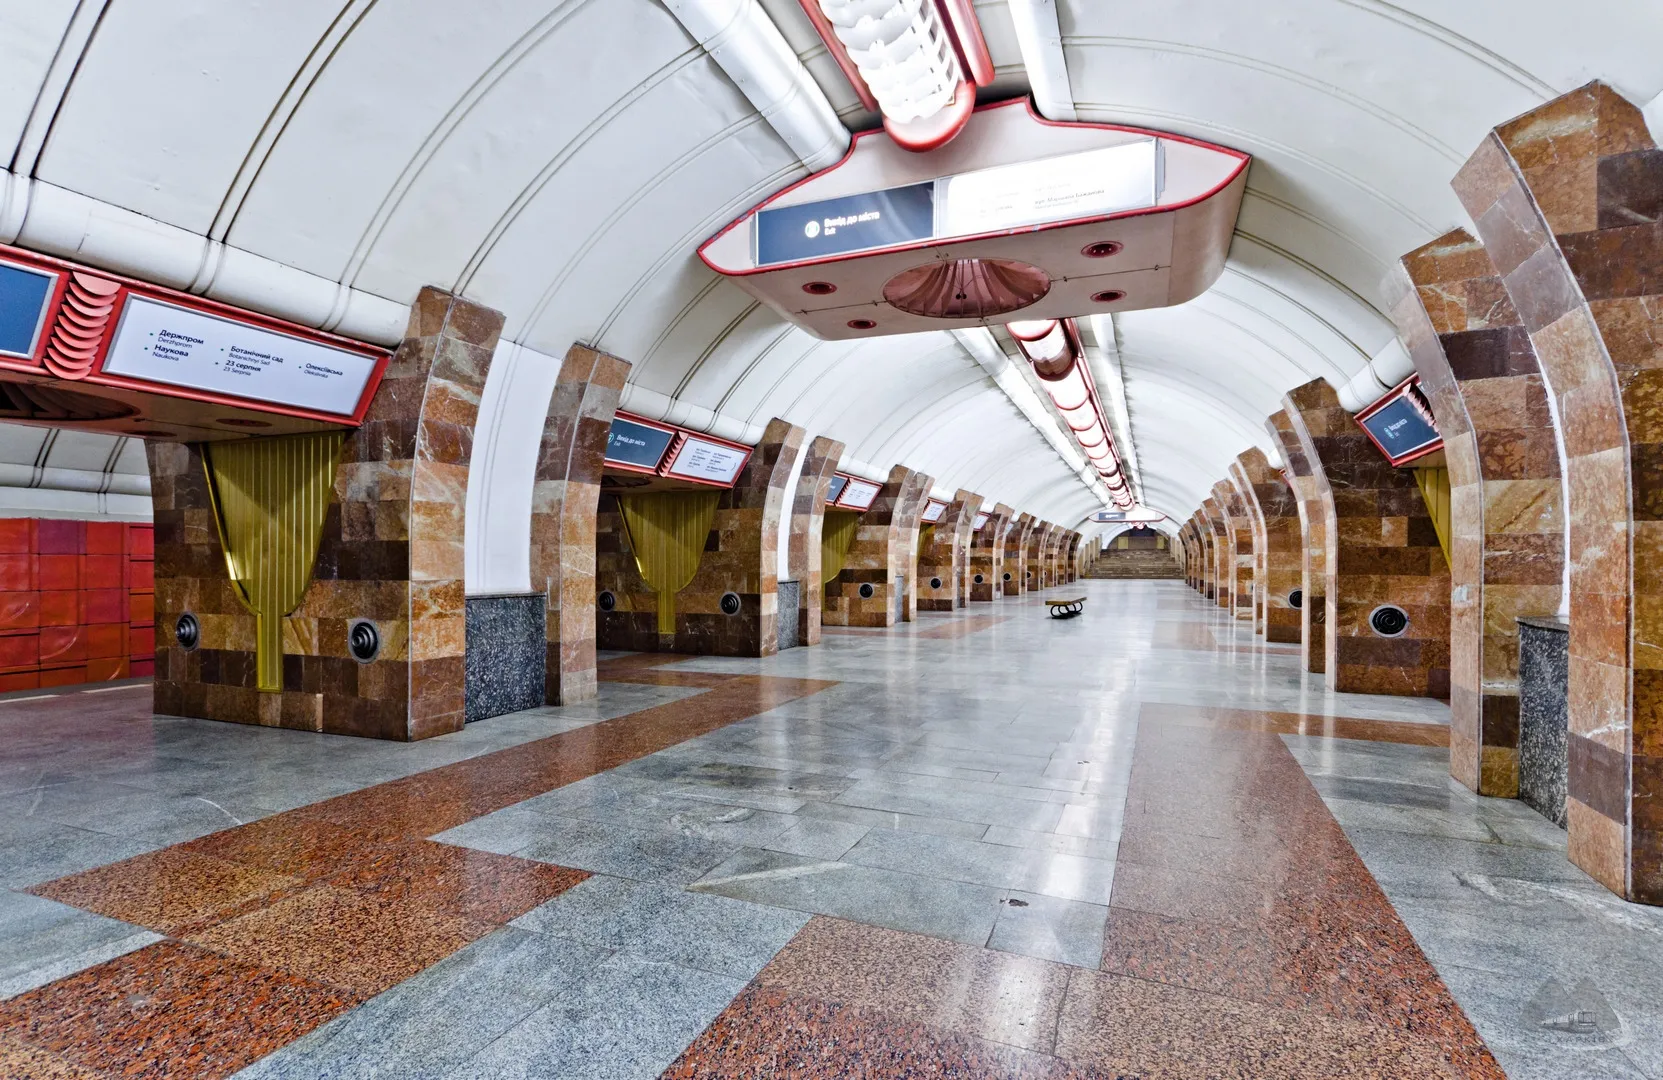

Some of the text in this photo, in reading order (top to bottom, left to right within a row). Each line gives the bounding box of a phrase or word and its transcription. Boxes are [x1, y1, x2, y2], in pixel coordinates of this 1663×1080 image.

[846, 215, 858, 226] до
[157, 336, 193, 349] Derzhprom
[159, 329, 204, 345] Держпром
[152, 351, 180, 361] Naukova
[154, 344, 189, 357] Наукова
[230, 345, 284, 364] Ботанічний сад
[225, 359, 262, 372] 23 серпня
